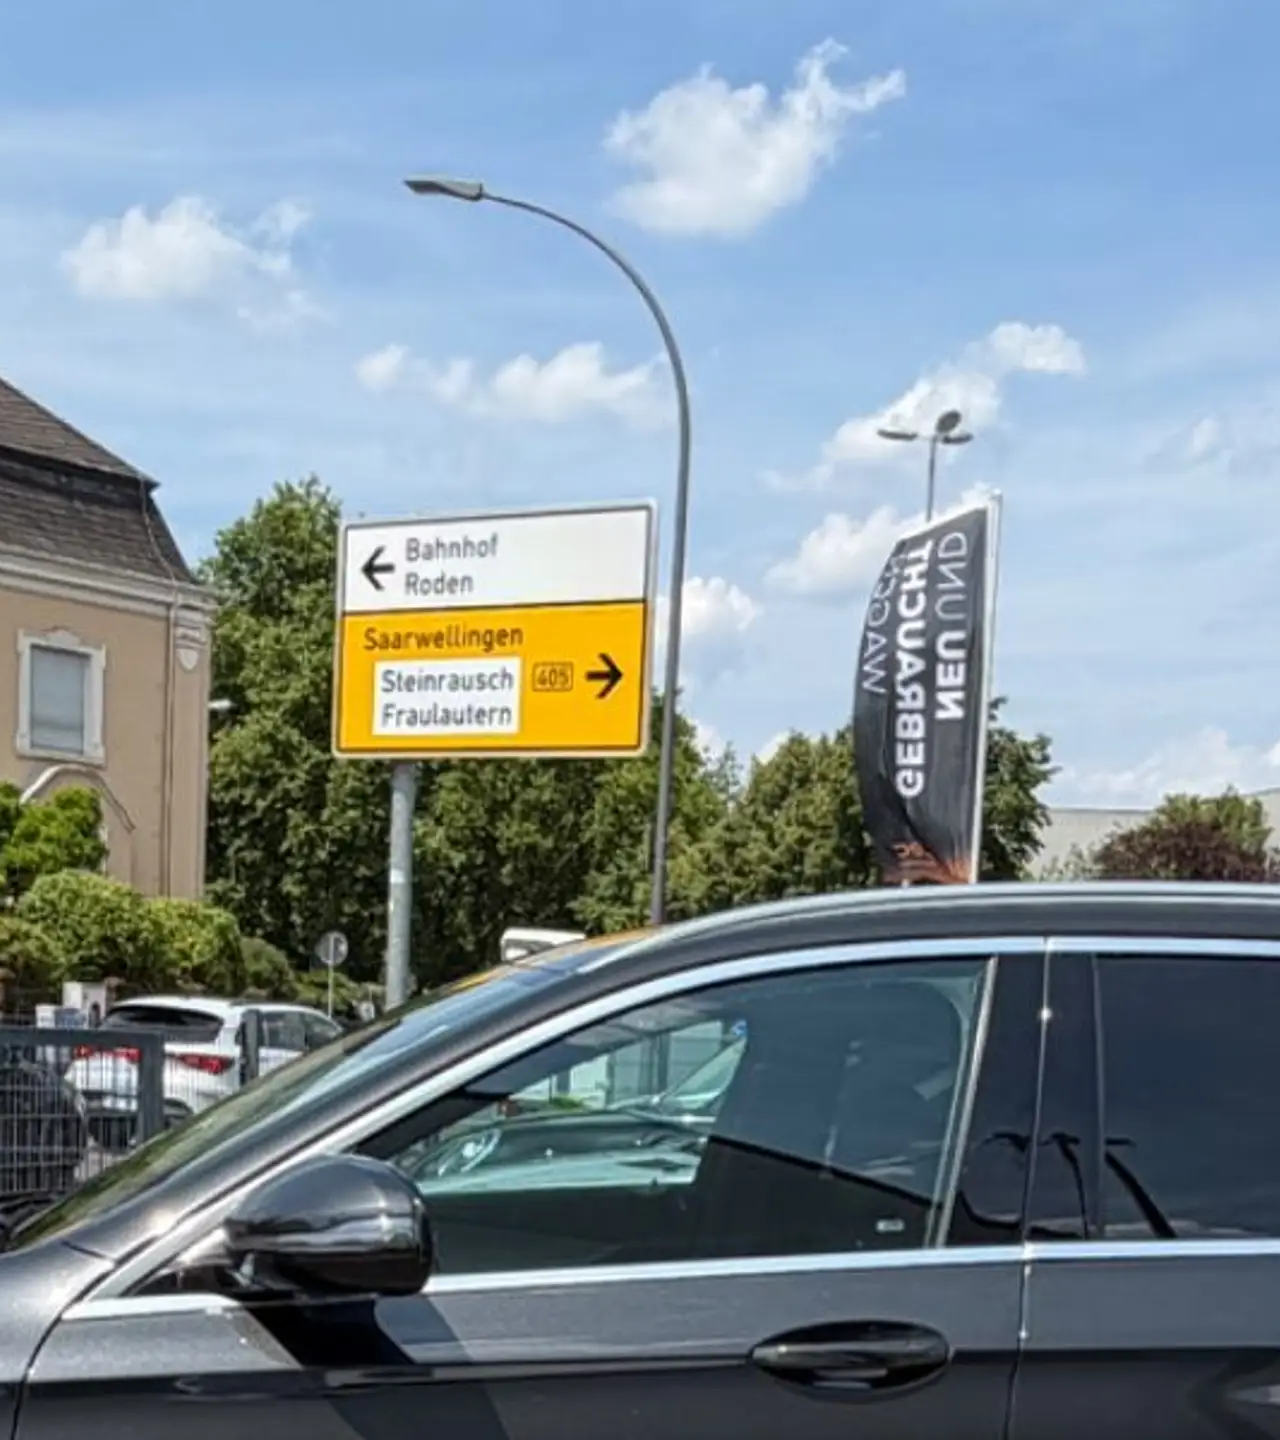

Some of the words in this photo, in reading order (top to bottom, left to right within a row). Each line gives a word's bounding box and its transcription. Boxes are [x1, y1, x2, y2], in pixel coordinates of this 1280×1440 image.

[405, 533, 499, 563] Bahnhof
[404, 573, 474, 597] Roden
[363, 625, 524, 653] Saarwellingen
[380, 667, 514, 694] Steinrausch
[536, 669, 570, 687] 405
[381, 702, 513, 728] Fraulautern
